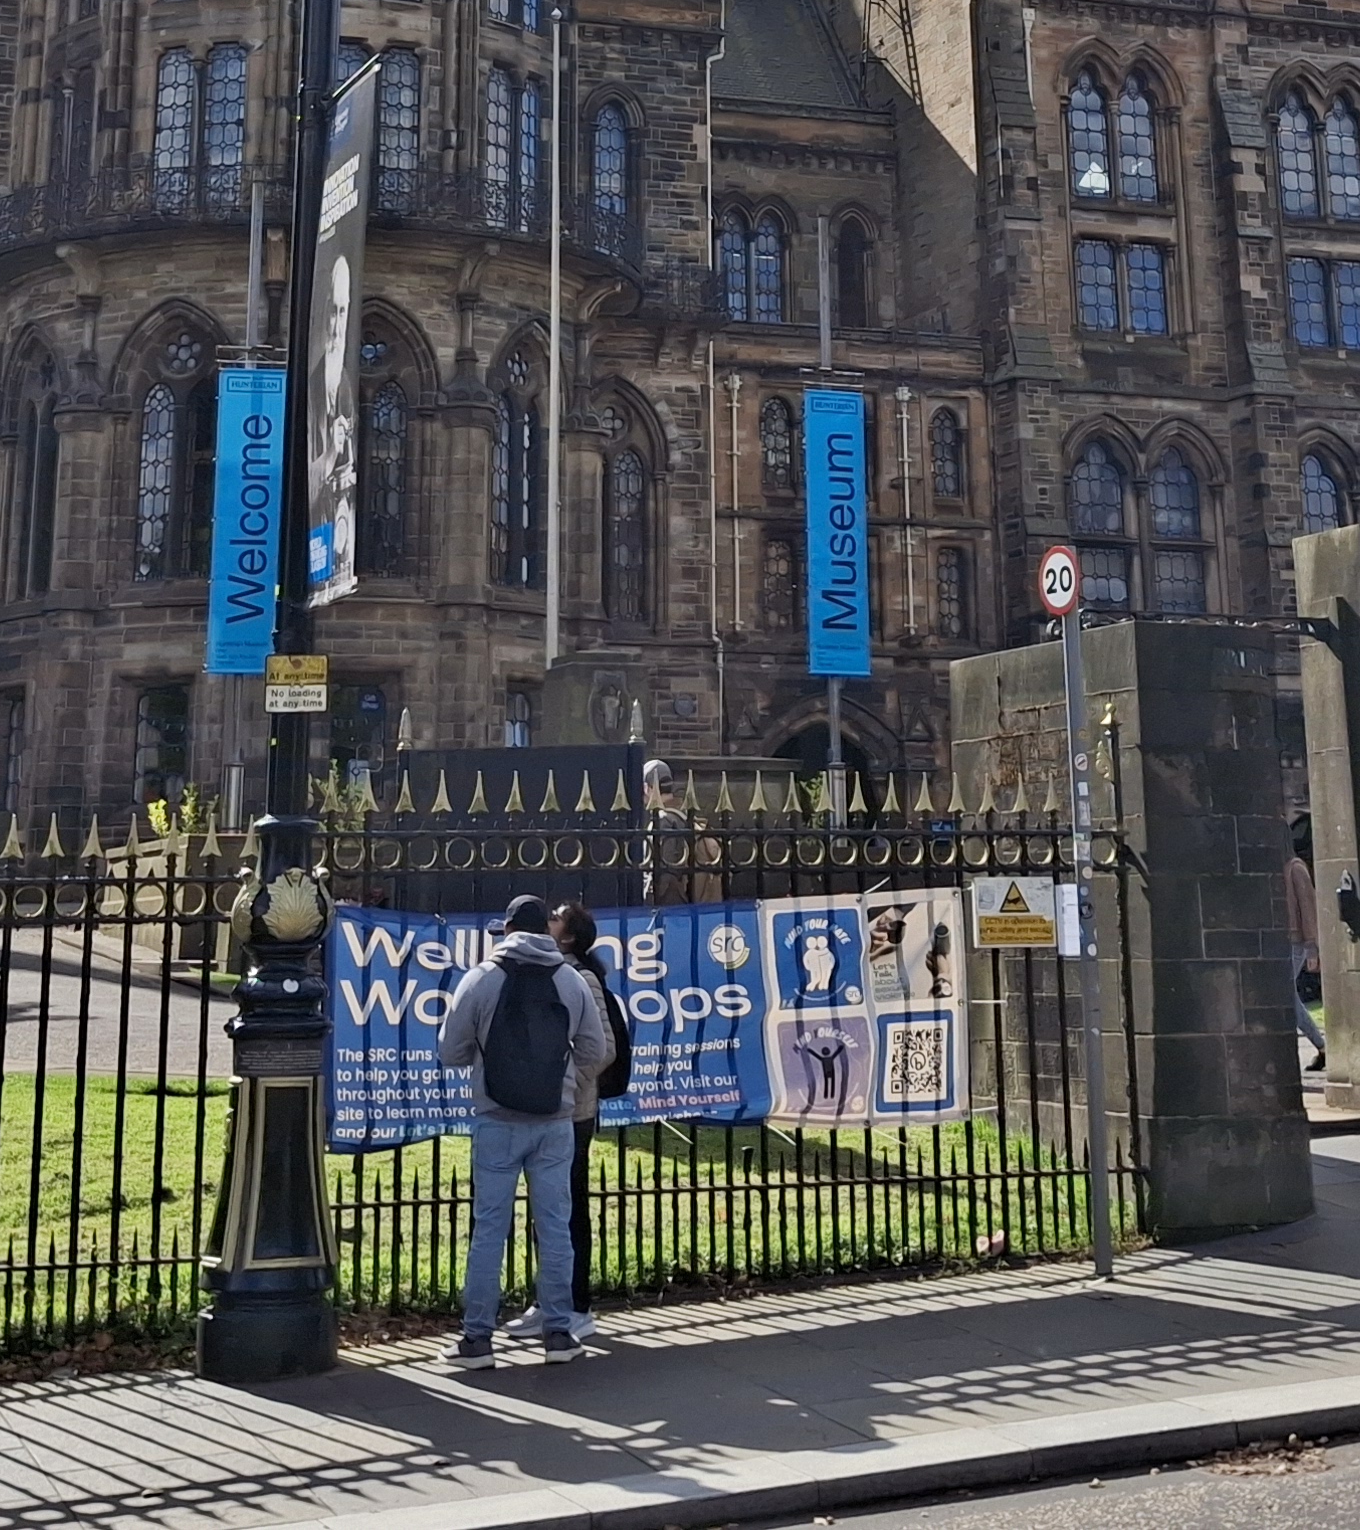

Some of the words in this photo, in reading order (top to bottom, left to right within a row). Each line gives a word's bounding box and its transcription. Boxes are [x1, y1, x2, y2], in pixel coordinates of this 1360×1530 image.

[225, 414, 273, 625] Welcome
[821, 433, 858, 631] Museum
[1045, 565, 1073, 595] 20
[269, 672, 280, 681] At
[283, 673, 300, 683] any
[302, 671, 325, 680] time
[269, 700, 278, 708] at
[282, 701, 300, 710] any
[302, 699, 323, 708] time
[271, 689, 285, 698] No
[288, 688, 322, 699] loading
[712, 935, 746, 954] src
[337, 1048, 364, 1062] The
[367, 1047, 397, 1062] SRC
[401, 1049, 433, 1062] runs
[631, 1041, 682, 1059] raining
[684, 1037, 741, 1054] sessions
[337, 1068, 352, 1083] to
[355, 1067, 388, 1085] help
[391, 1069, 419, 1085] you
[422, 1066, 455, 1085] gain
[634, 1061, 664, 1077] help
[667, 1059, 693, 1076] you
[337, 1086, 421, 1105] throughout
[423, 1088, 457, 1104] your
[628, 1077, 678, 1096] eyond.
[680, 1074, 711, 1089] Visit
[713, 1074, 738, 1087] our
[336, 1106, 364, 1121] site
[368, 1107, 383, 1120] to
[386, 1106, 425, 1120] learn
[428, 1107, 467, 1118] more
[638, 1095, 676, 1110] Mind
[677, 1089, 741, 1107] Yourself
[335, 1126, 367, 1139] and
[370, 1127, 397, 1139] our
